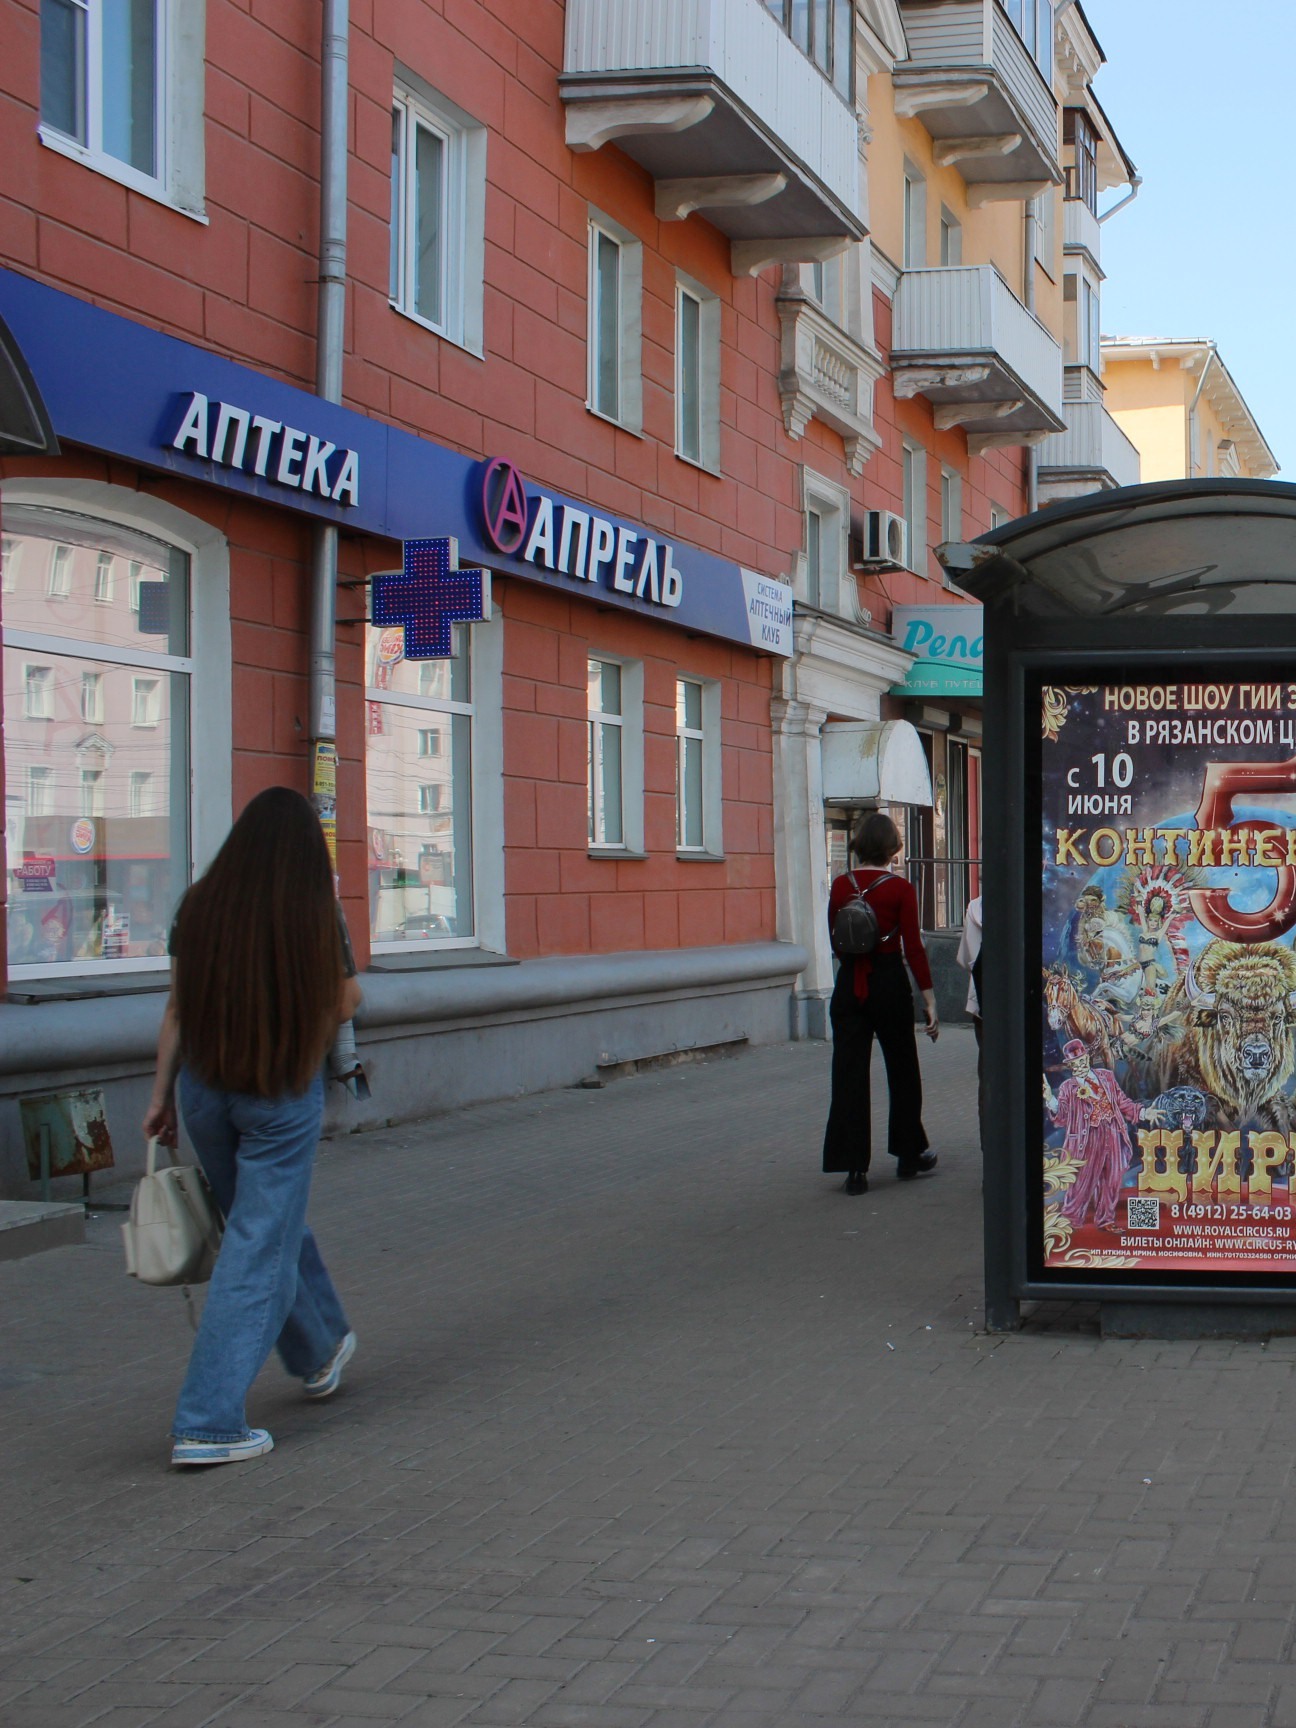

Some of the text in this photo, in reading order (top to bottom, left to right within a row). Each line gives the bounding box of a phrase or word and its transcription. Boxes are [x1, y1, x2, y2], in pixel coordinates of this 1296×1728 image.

[173, 391, 359, 507] АПТЕКА
[524, 496, 683, 608] АПРЕЛЬ
[757, 582, 783, 602] СИСТЕМА
[749, 598, 791, 627] АПТЕЧНЫЙ
[761, 623, 781, 645] КЛУБ
[905, 680, 938, 689] КЛУБ
[1104, 685, 1177, 710] НОВОЕ
[1184, 685, 1233, 710] ШОУ
[1239, 685, 1281, 710] ГИИ
[1127, 720, 1140, 744] В
[1146, 719, 1273, 744] РЯЗАНСКОМ
[1091, 753, 1134, 788] 10
[1068, 795, 1132, 815] ИЮНЯ
[16, 865, 51, 876] РАБОТУ
[1171, 1203, 1292, 1220] 8 (4912) 25-64-03
[1173, 1225, 1290, 1237] WWW.ROYALCIRCUS.RU
[1120, 1236, 1162, 1247] БИЛЕТЫ
[1165, 1237, 1213, 1248] ОНЛАЙН:
